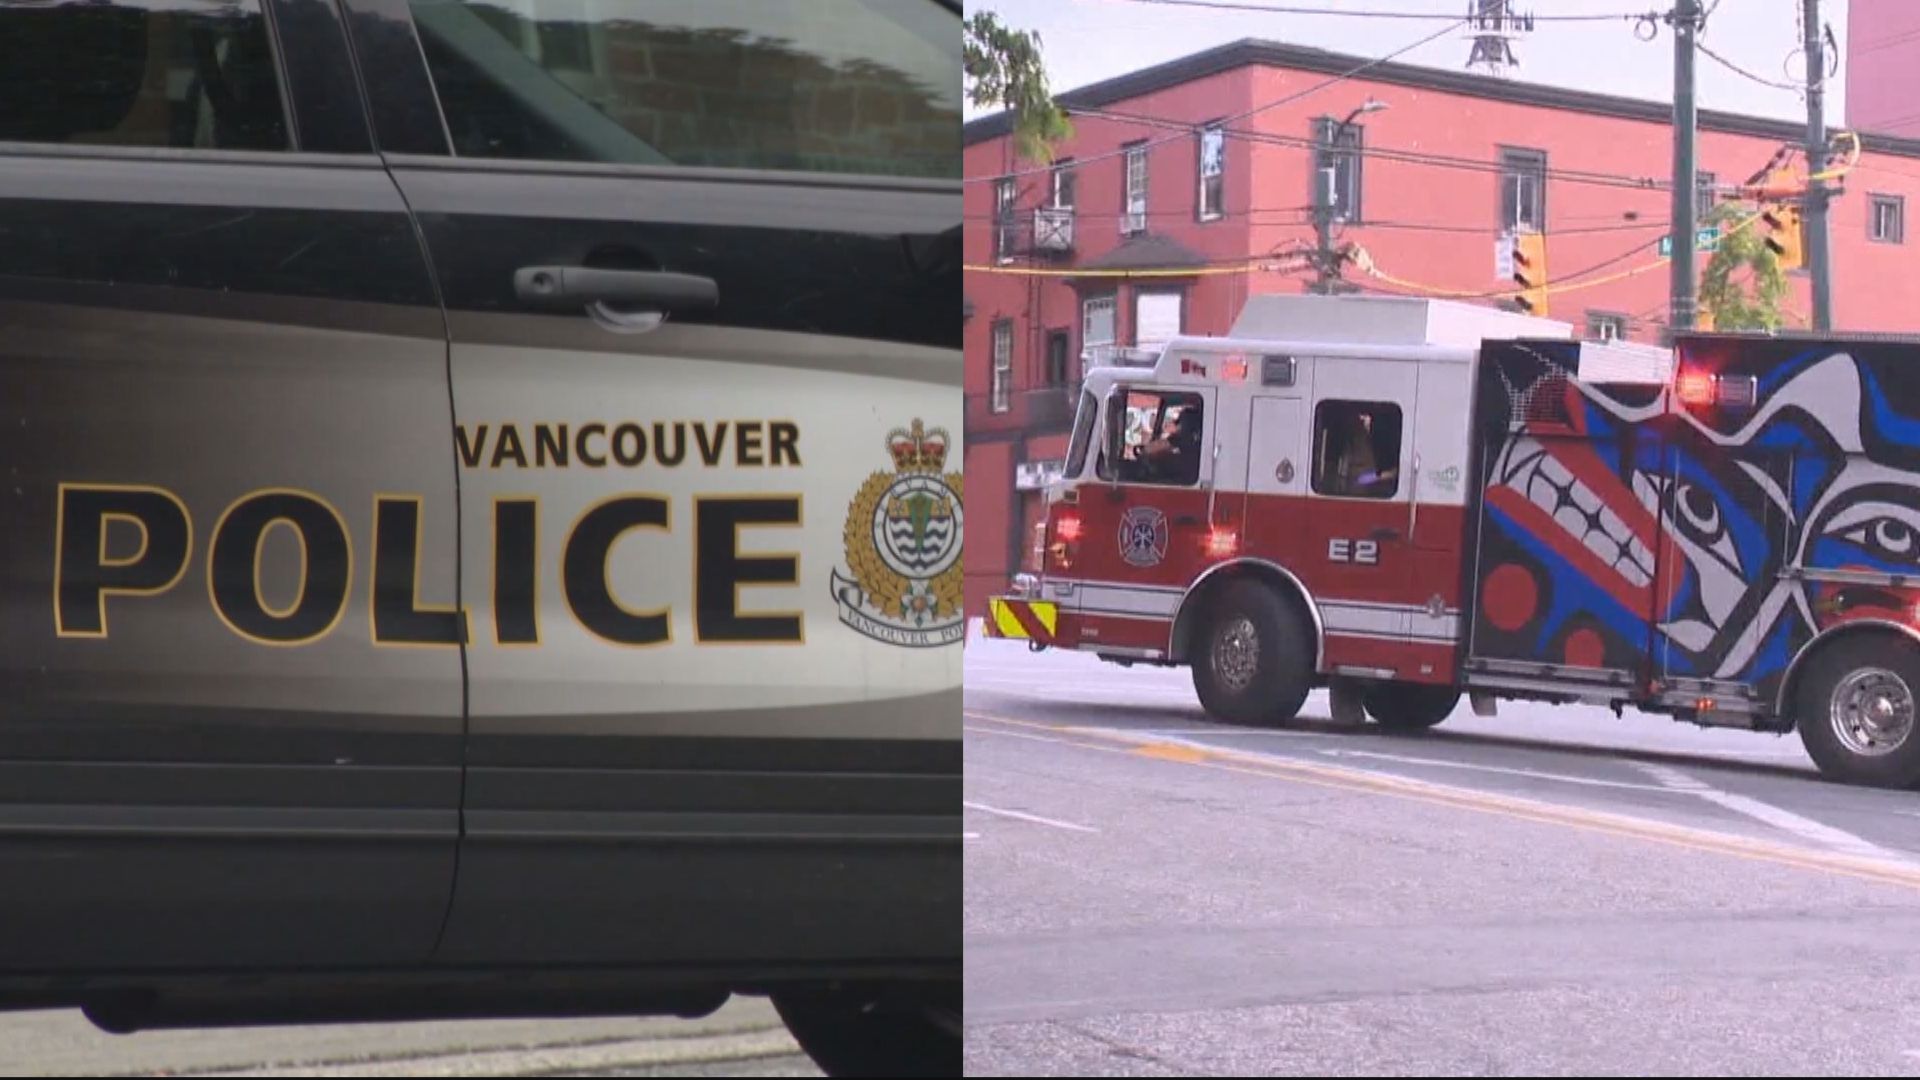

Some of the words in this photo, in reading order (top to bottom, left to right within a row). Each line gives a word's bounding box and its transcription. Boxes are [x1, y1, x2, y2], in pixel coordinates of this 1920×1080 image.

[454, 419, 801, 468] VANCOUVER
[54, 482, 804, 648] POLICE
[1329, 539, 1377, 563] E2
[848, 609, 928, 645] VANCOUVER
